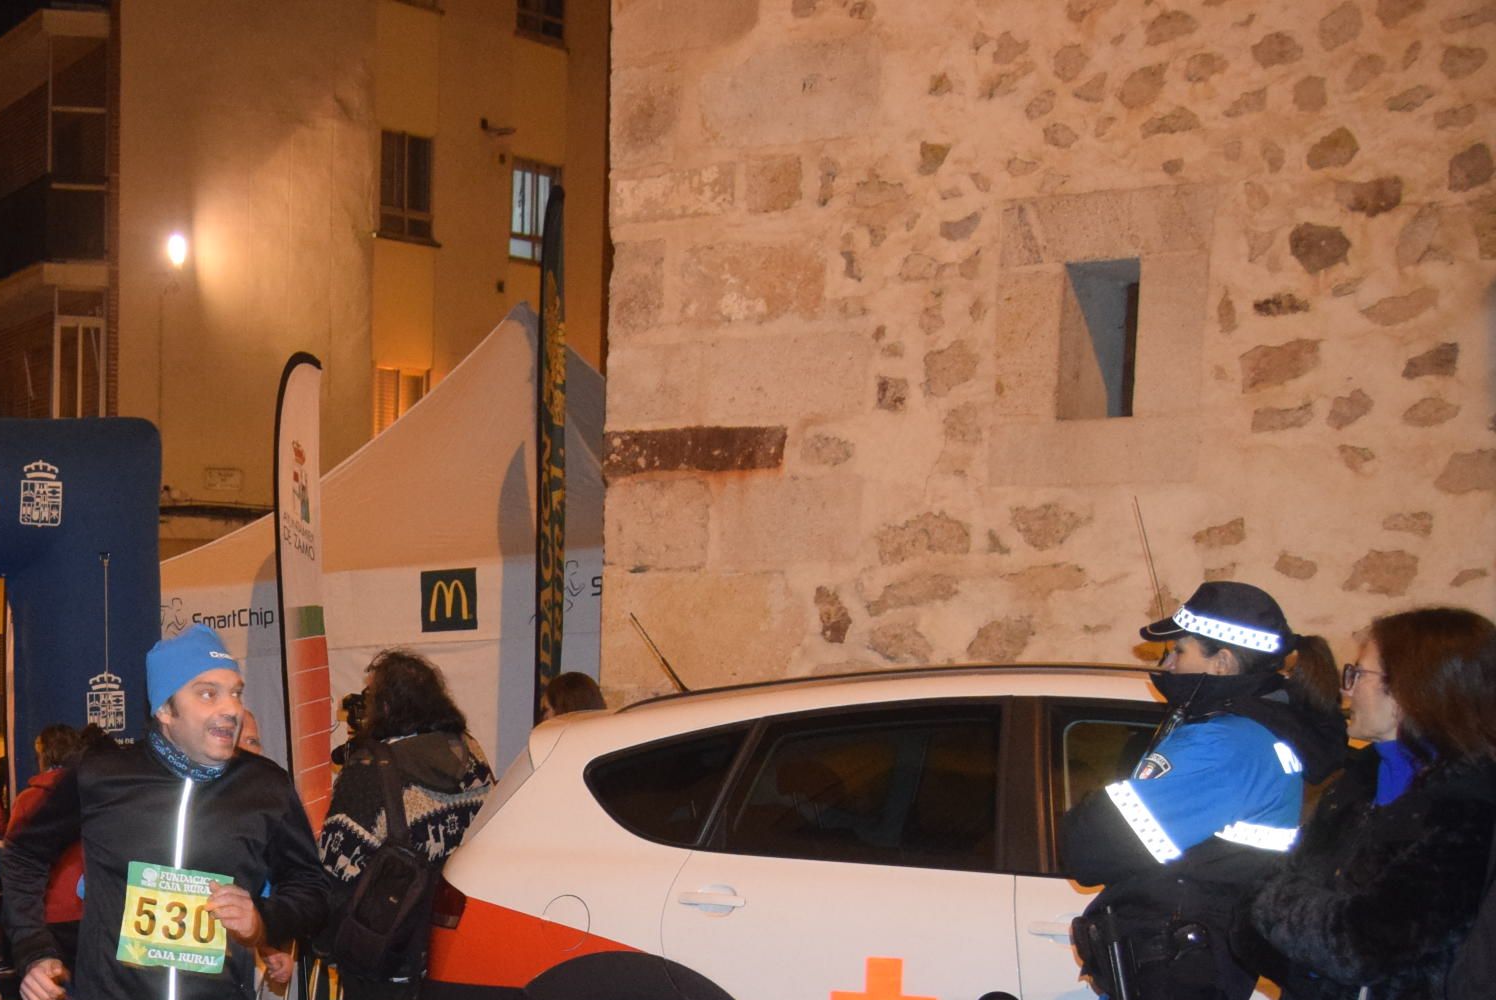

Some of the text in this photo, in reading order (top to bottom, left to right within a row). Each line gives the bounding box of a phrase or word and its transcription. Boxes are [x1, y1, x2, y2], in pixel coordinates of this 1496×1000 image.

[294, 533, 315, 561] ZAMO
[191, 607, 274, 629] SmartChip
[183, 882, 212, 895] RURA
[133, 896, 216, 944] 530
[178, 952, 218, 966] RURAL
